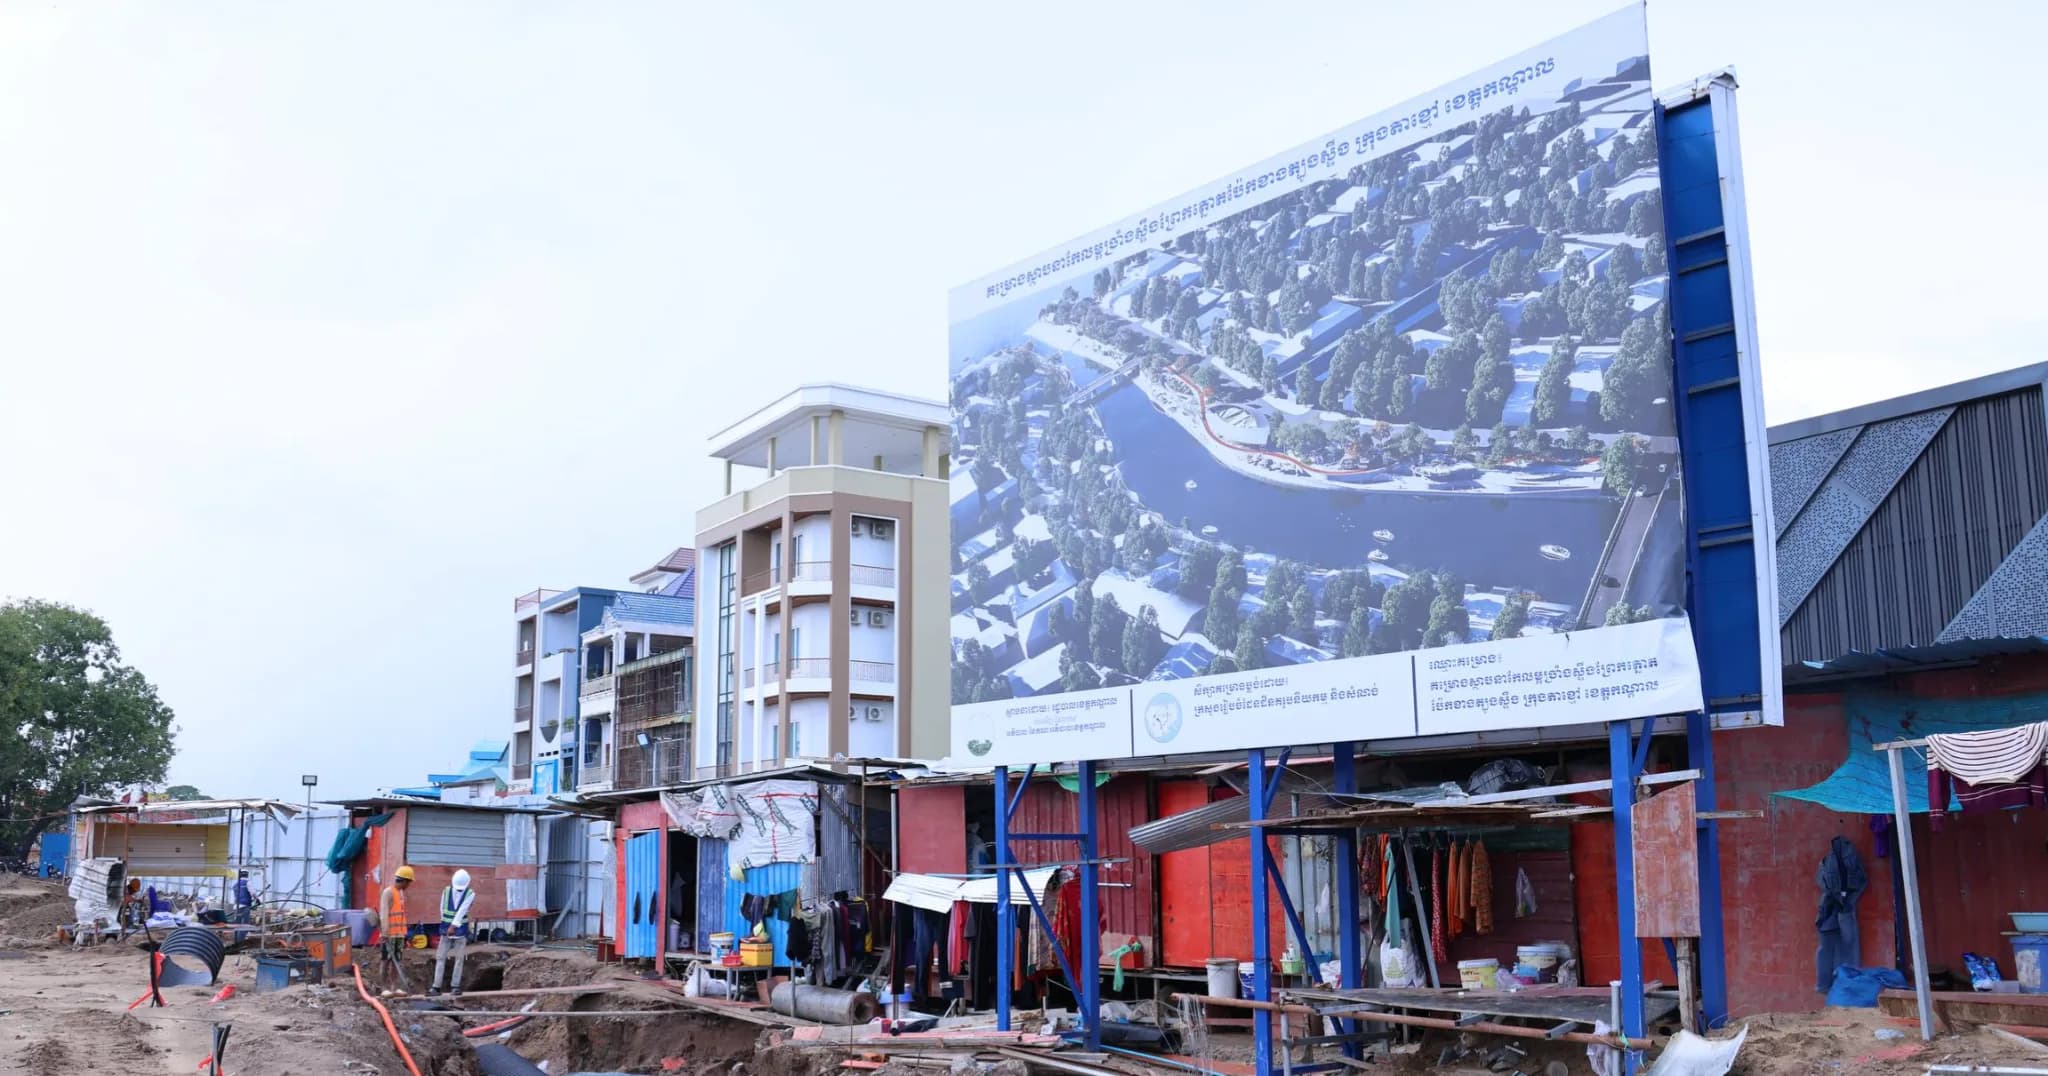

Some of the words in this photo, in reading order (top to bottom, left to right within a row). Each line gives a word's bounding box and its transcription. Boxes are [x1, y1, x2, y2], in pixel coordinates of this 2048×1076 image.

[1356, 100, 1438, 154] ក្រុងតាខ្មៅ
